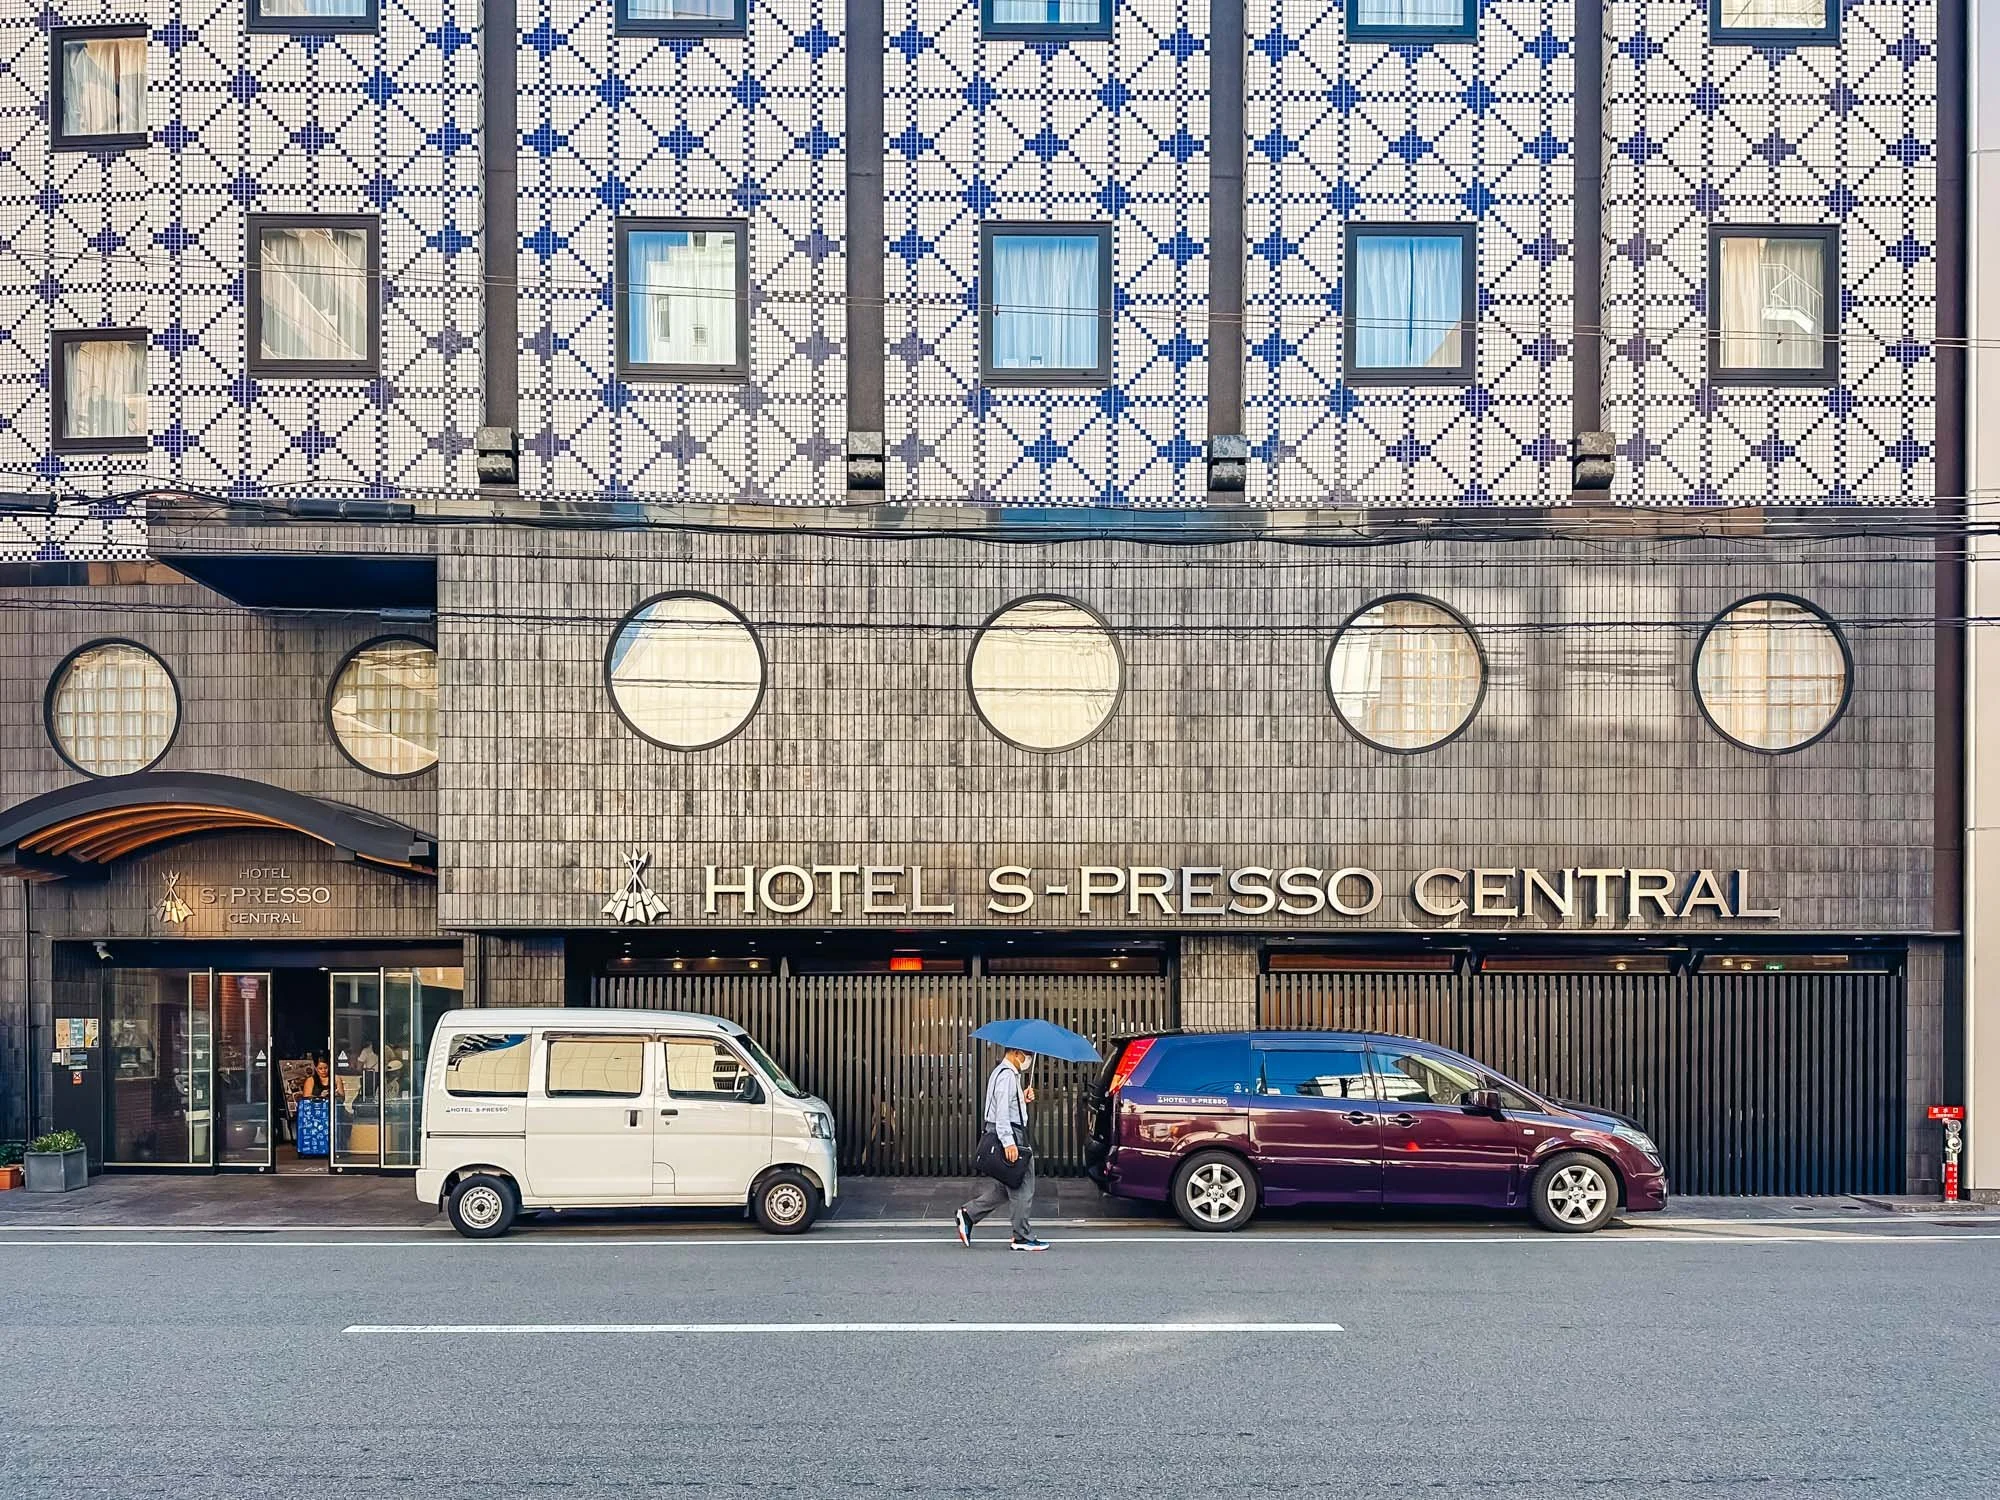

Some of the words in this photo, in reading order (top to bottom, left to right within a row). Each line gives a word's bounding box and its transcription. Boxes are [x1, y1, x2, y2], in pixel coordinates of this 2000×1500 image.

[239, 867, 291, 880] HOTEL
[200, 887, 331, 904] S-PRESSO
[704, 863, 955, 915] HOTEL
[987, 865, 1383, 916] S-PRESSO
[1413, 866, 1781, 918] CENTRAL
[228, 912, 302, 924] CENTRAL
